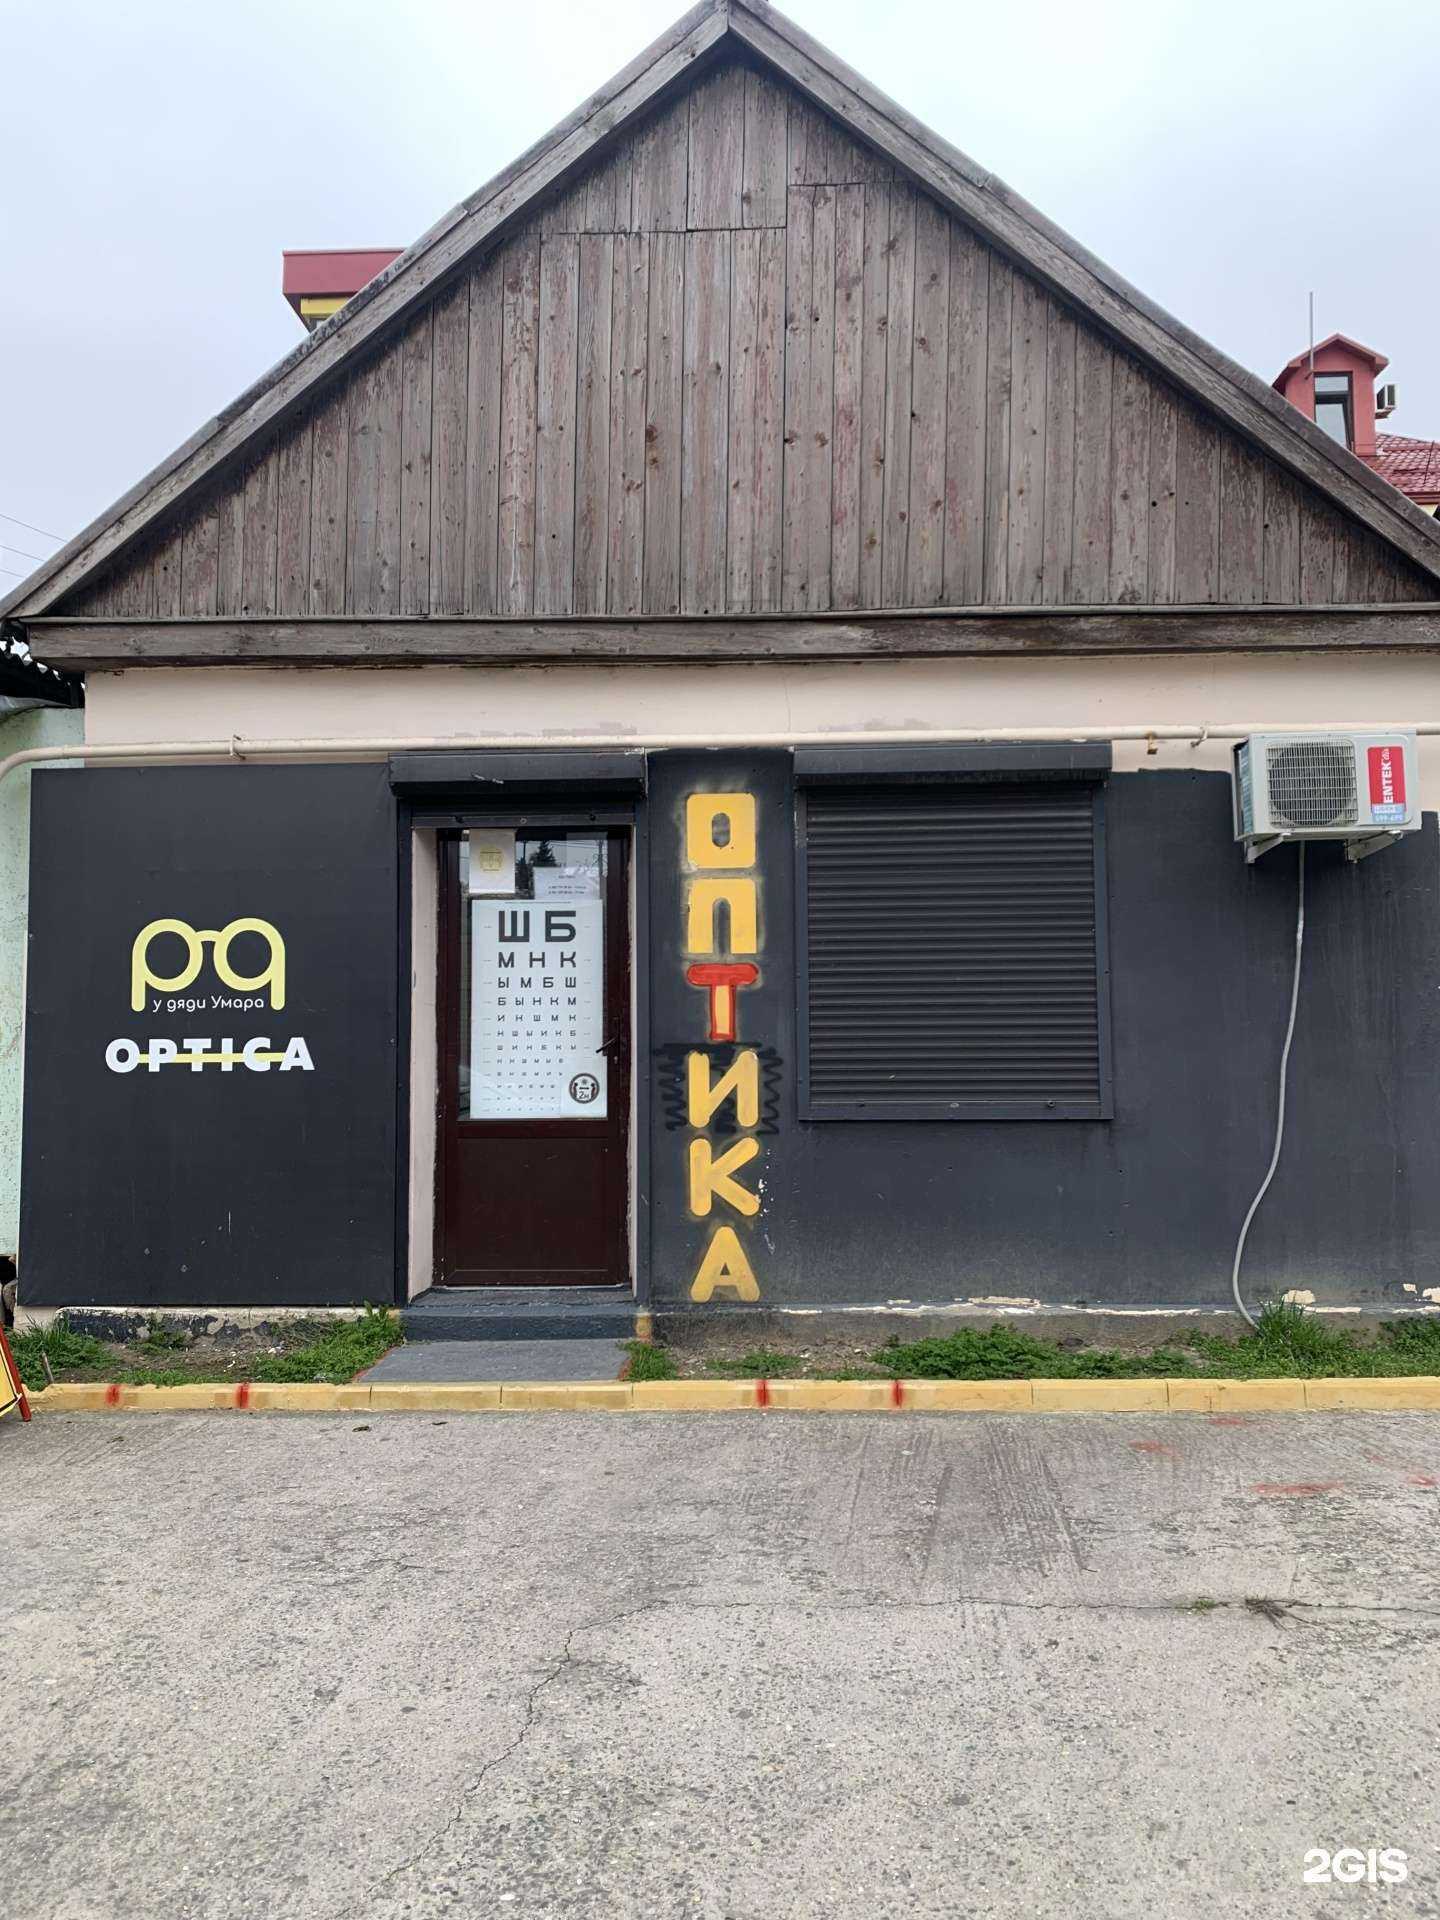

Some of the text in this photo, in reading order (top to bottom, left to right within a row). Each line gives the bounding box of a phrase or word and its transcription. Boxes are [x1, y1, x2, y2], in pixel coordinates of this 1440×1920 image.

[1381, 758, 1394, 804] ENTEK
[152, 995, 264, 1012] у дяди Умара
[105, 1037, 315, 1073] OPTICA
[686, 792, 760, 1302] ОПТИКА
